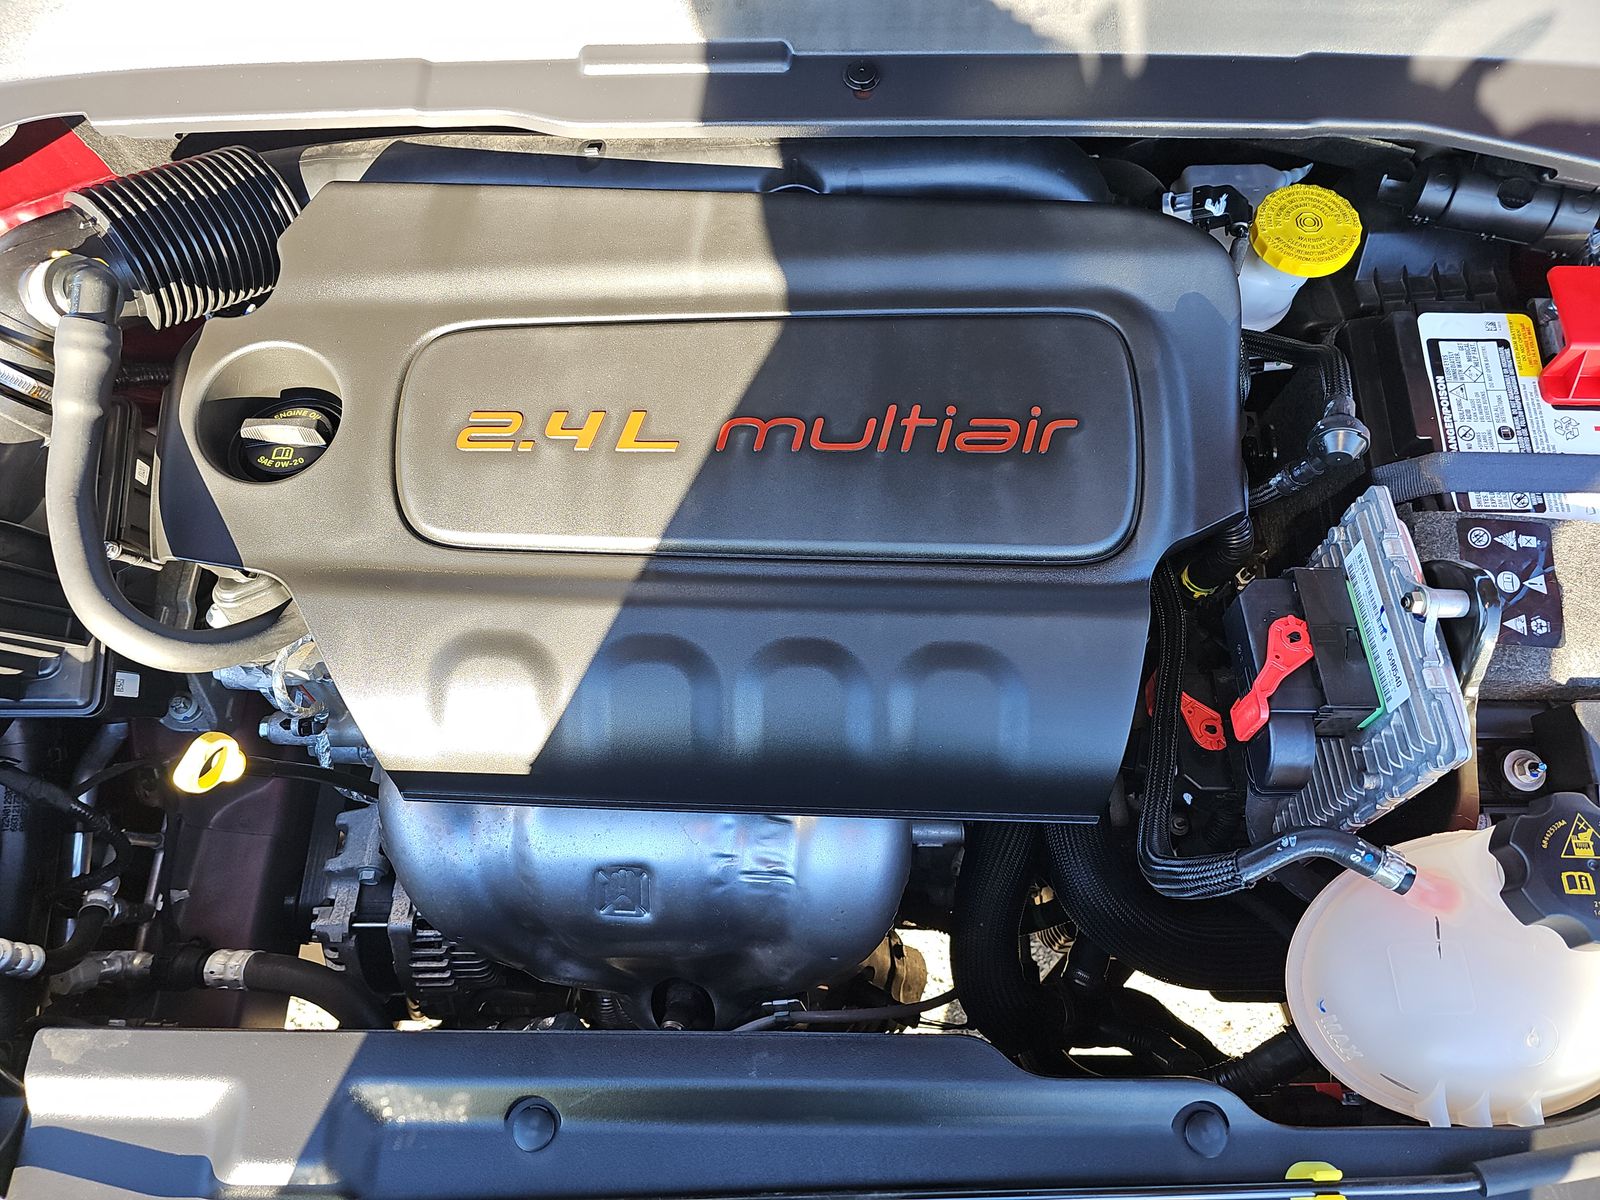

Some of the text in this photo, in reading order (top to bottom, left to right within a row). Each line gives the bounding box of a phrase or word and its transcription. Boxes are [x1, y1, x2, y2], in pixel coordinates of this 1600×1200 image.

[274, 410, 308, 420] ENGINE
[714, 404, 1080, 455] multiair
[1435, 376, 1458, 452] ANGER/POISON
[257, 456, 274, 467] SAE
[1386, 648, 1402, 688] 6590540
